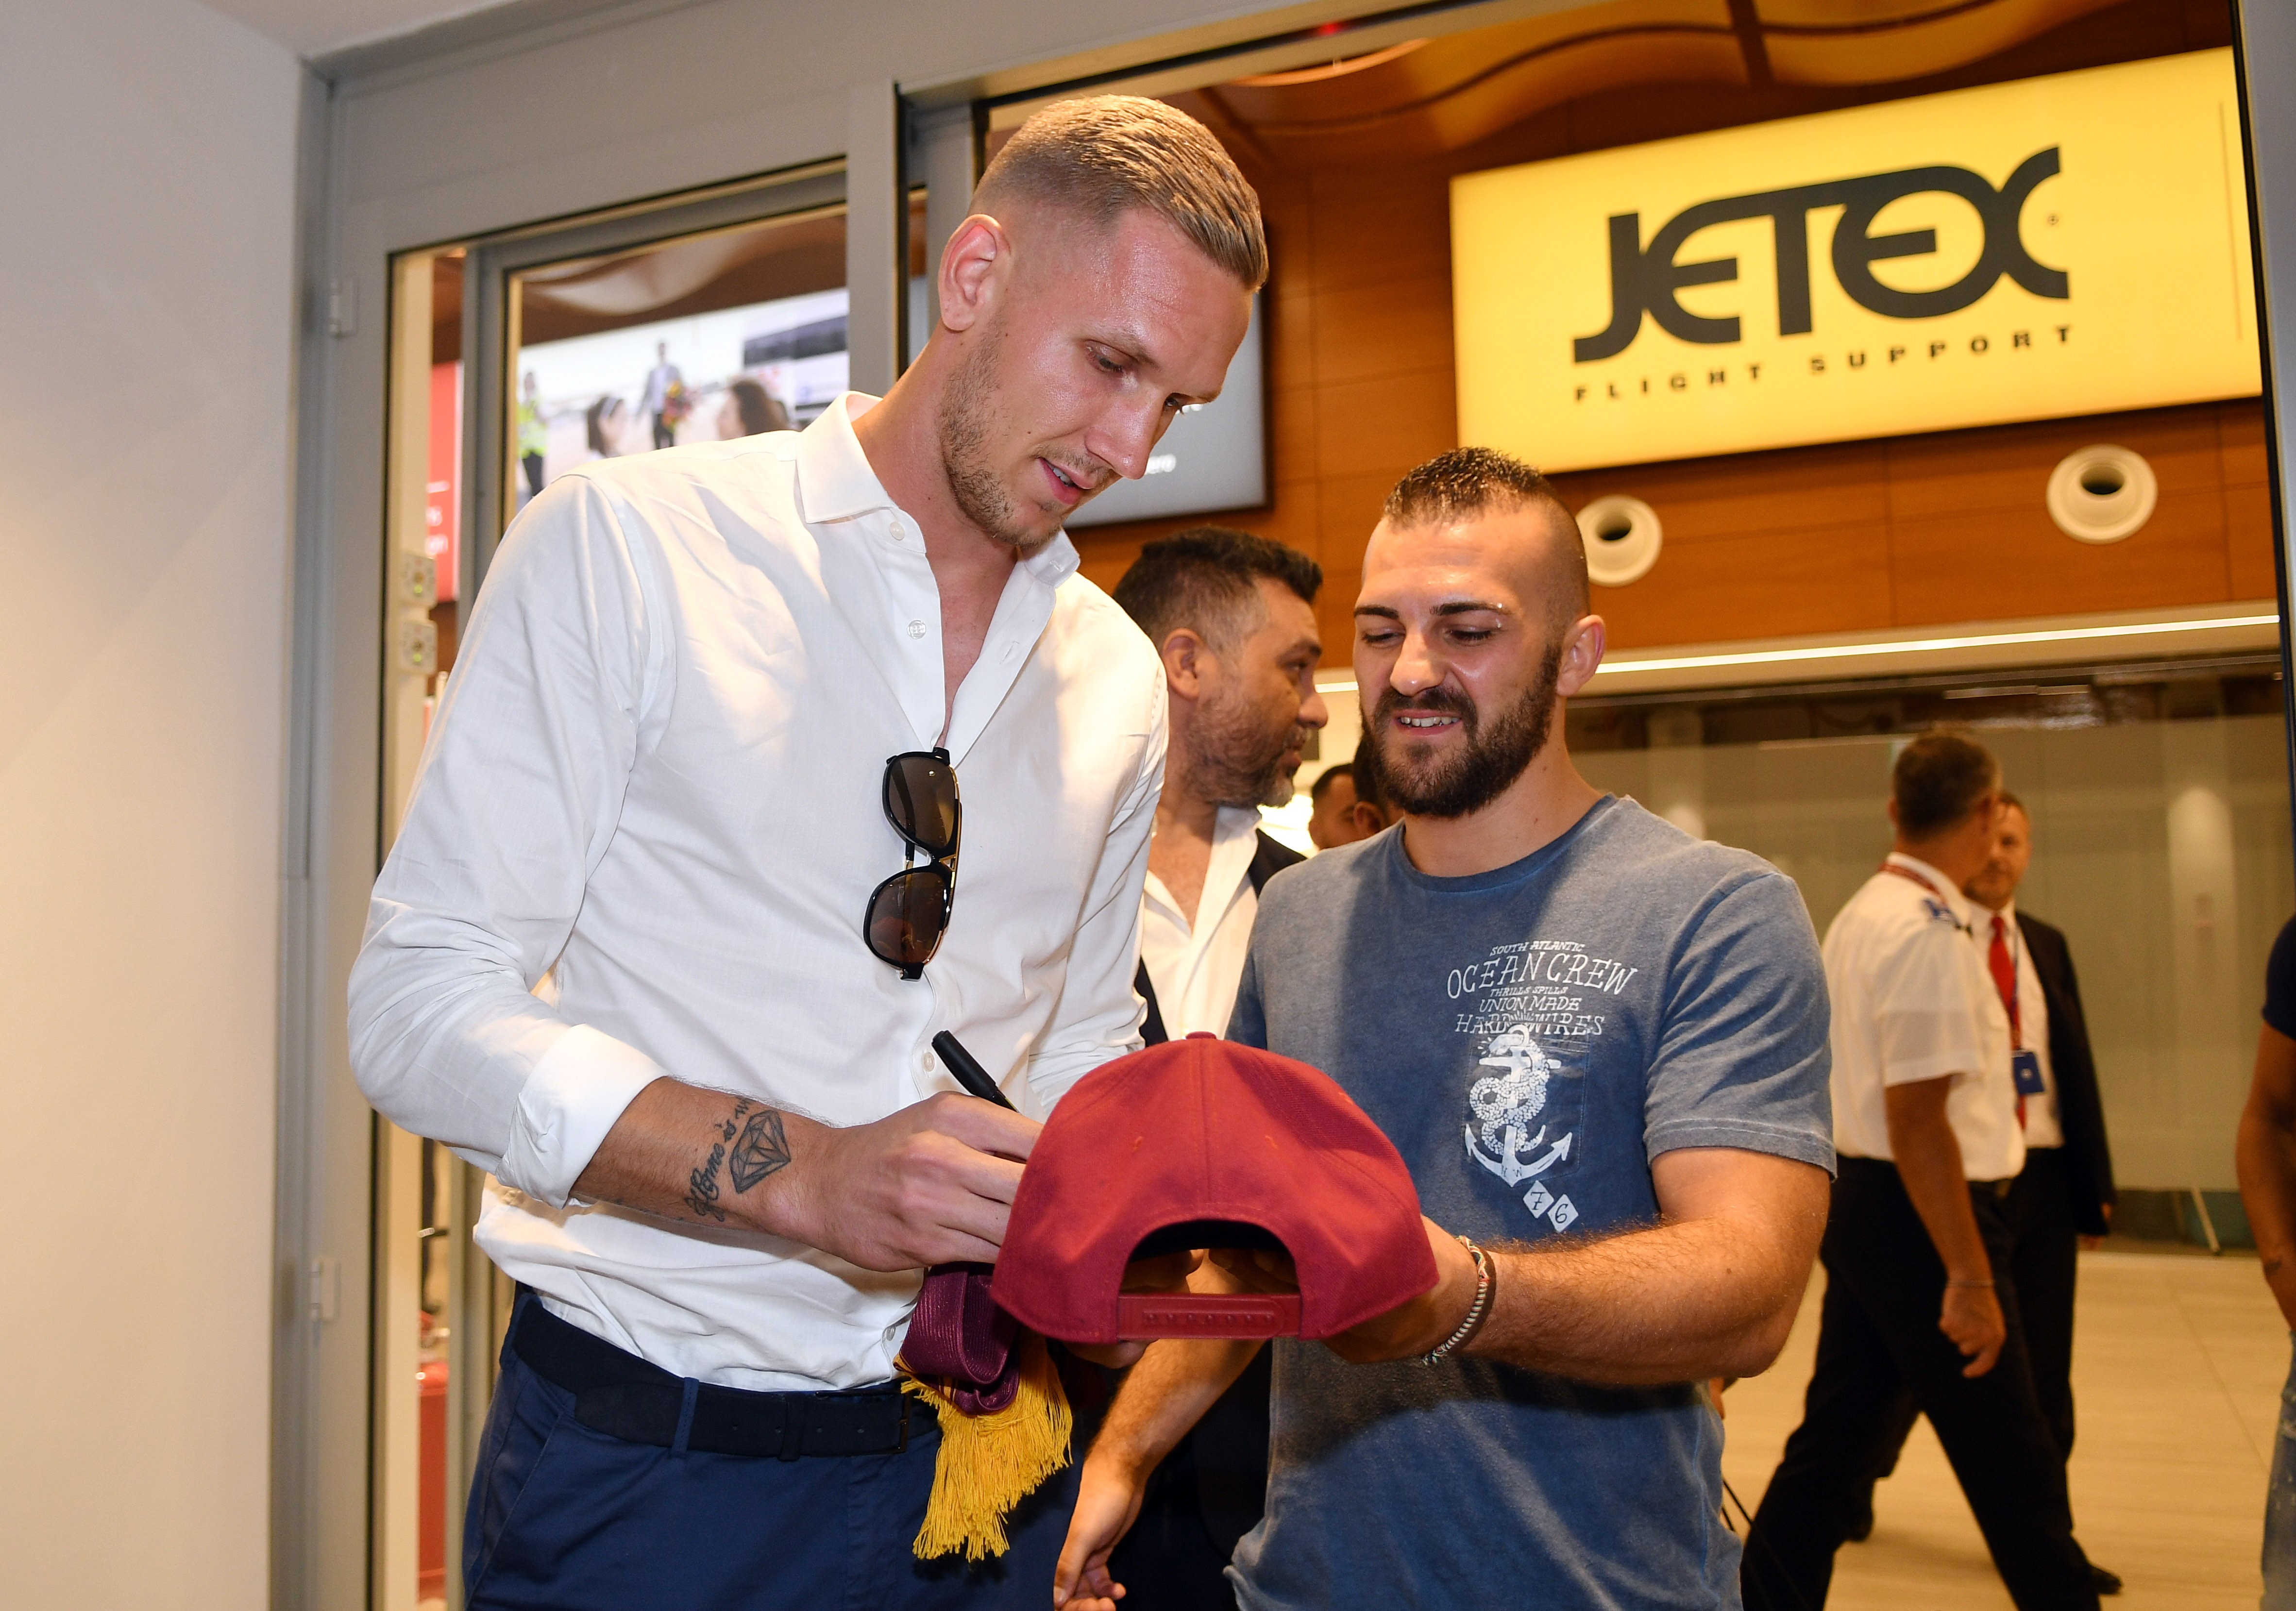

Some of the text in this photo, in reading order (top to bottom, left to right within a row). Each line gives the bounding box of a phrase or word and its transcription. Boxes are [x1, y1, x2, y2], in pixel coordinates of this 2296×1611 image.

[1573, 146, 2070, 364] JETEX
[1575, 325, 2072, 402] FLIGHT SUPPORT
[1489, 940, 1586, 957] SOUTH ATLANTIC
[1447, 951, 1639, 999] OCEAN CREW
[1490, 986, 1569, 997] THRILLS SPILLS
[1479, 995, 1583, 1012] UNION MADE
[1530, 1191, 1569, 1224] 7 6
